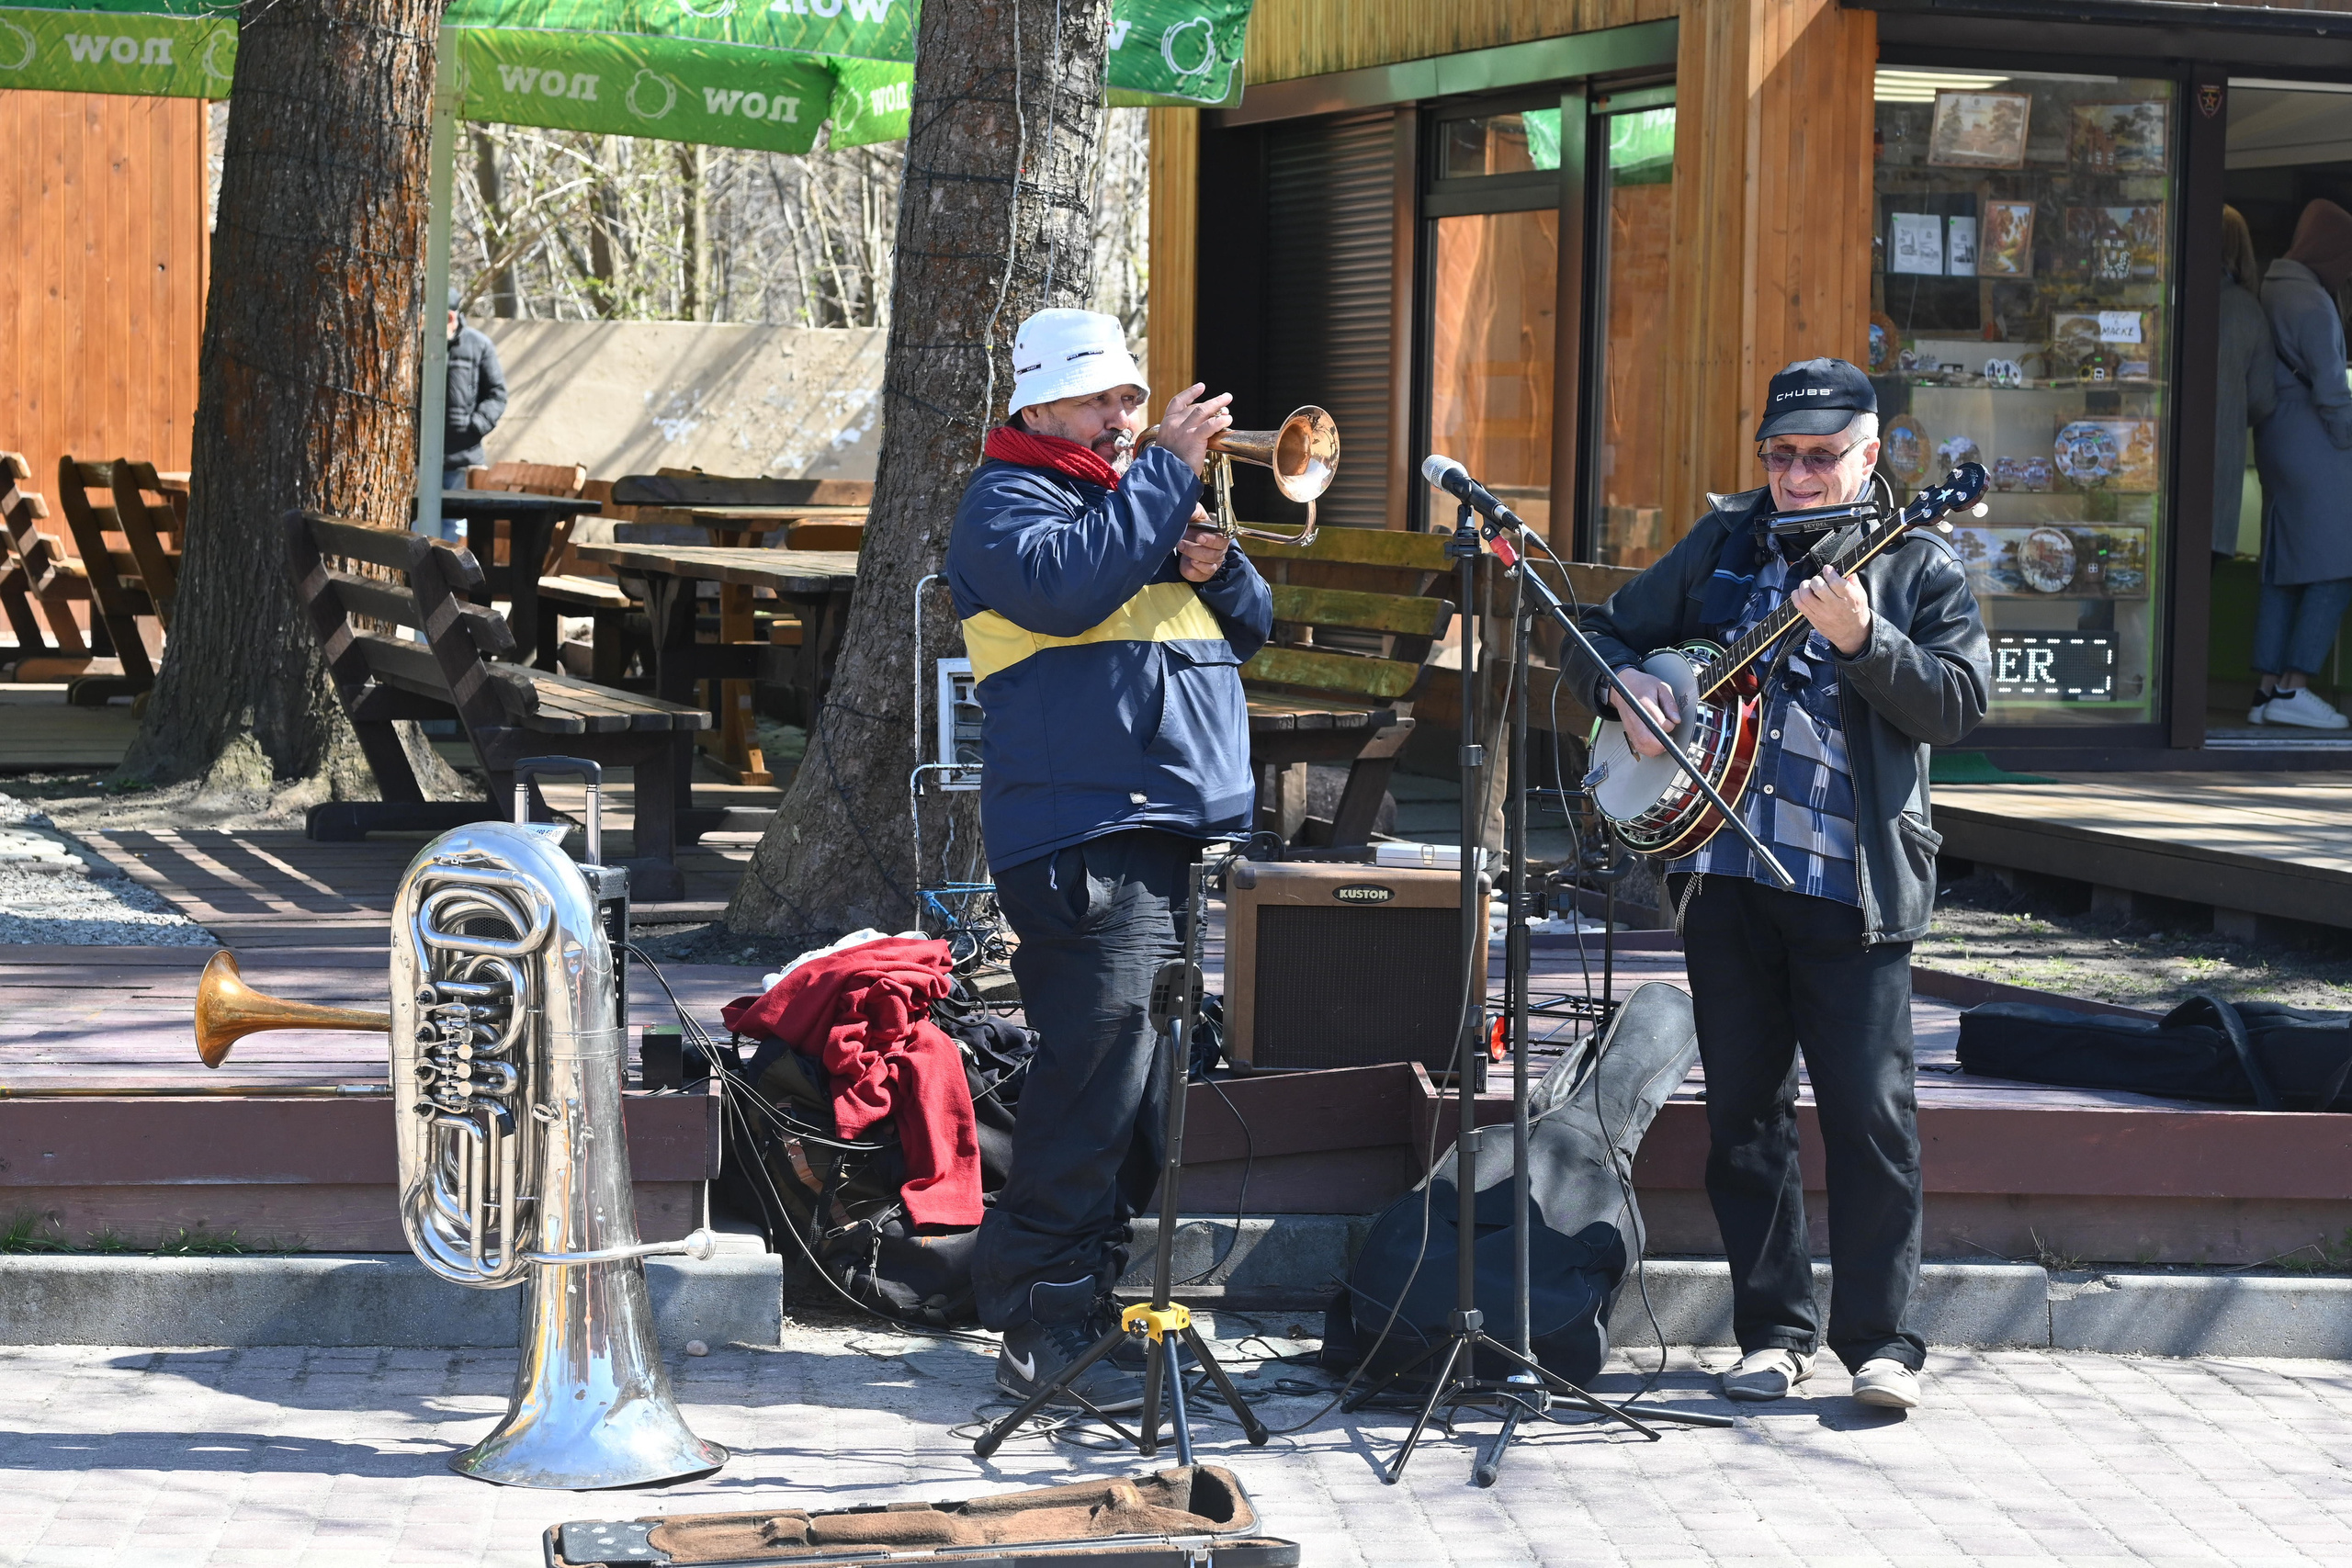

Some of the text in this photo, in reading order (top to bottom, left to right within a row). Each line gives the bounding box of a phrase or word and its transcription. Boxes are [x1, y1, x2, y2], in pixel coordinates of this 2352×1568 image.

[1776, 389, 1831, 401] CHUBB
[1994, 649, 2056, 683] ER
[1340, 888, 1389, 899] KUSTOM
